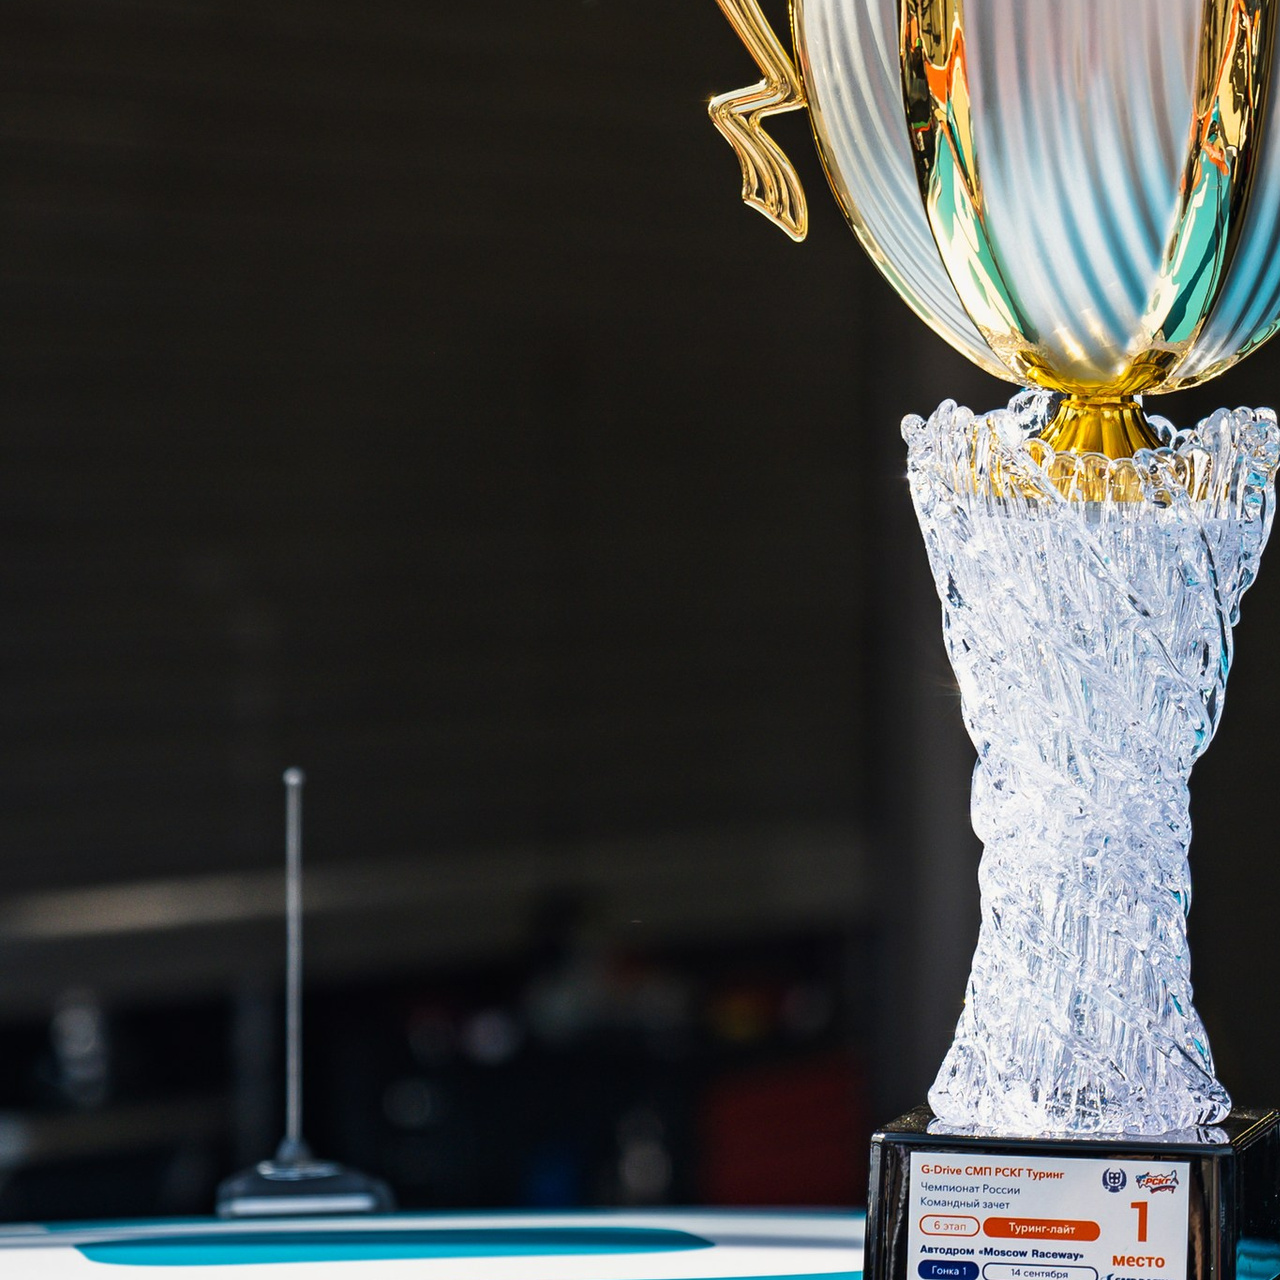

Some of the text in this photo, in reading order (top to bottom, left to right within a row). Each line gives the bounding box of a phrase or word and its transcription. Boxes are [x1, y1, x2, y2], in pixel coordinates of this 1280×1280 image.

[921, 1164, 1065, 1181] G-Drive СМП РСКГ Туринг
[921, 1182, 1020, 1195] Чемпионат России
[920, 1196, 1010, 1210] Командный зачет
[933, 1220, 967, 1232] 6 этап
[1008, 1221, 1076, 1235] Туринг-лайт
[1130, 1201, 1148, 1242] 1
[920, 1244, 975, 1257] Автодром
[1112, 1255, 1166, 1269] место
[931, 1265, 968, 1276] Гонка 1
[1011, 1268, 1069, 1280] 14 сентября
